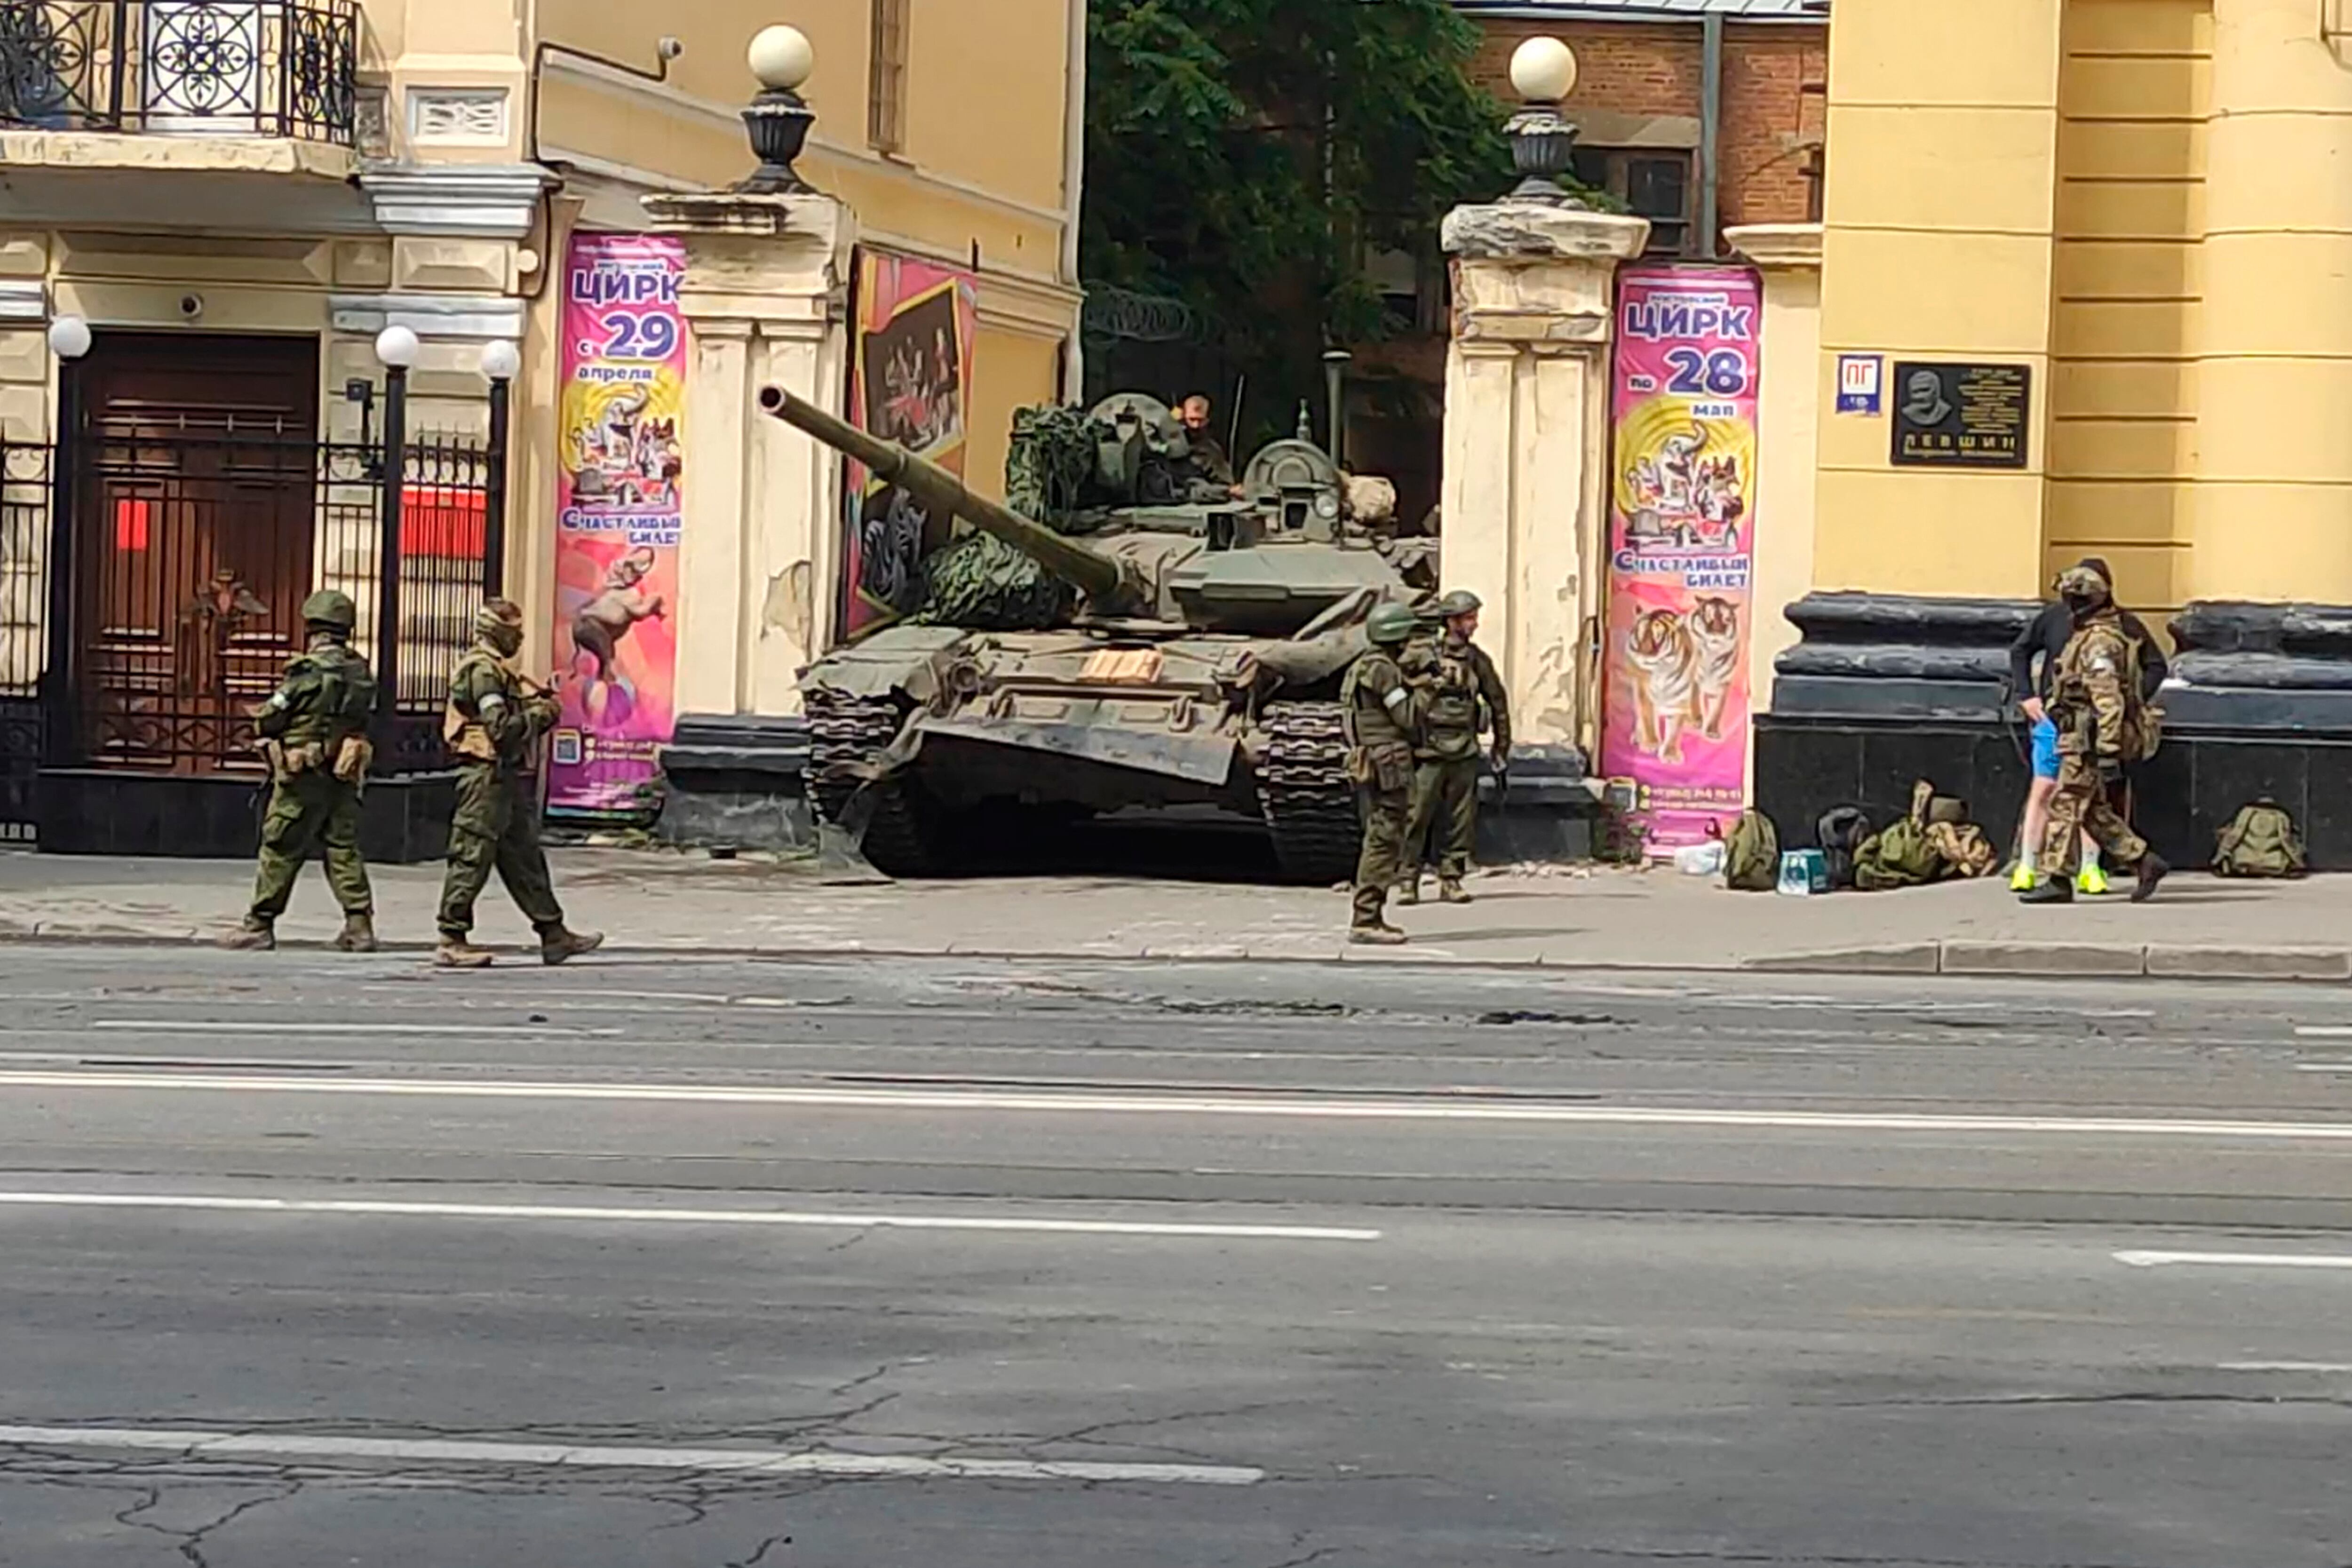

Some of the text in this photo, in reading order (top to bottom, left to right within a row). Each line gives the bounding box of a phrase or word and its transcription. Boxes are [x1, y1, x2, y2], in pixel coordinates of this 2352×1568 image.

[575, 272, 684, 304] ЦИРК
[604, 314, 674, 357] 29
[1628, 305, 1747, 338] ЦИРК
[579, 367, 653, 382] апреля
[1630, 350, 1744, 393] по 28
